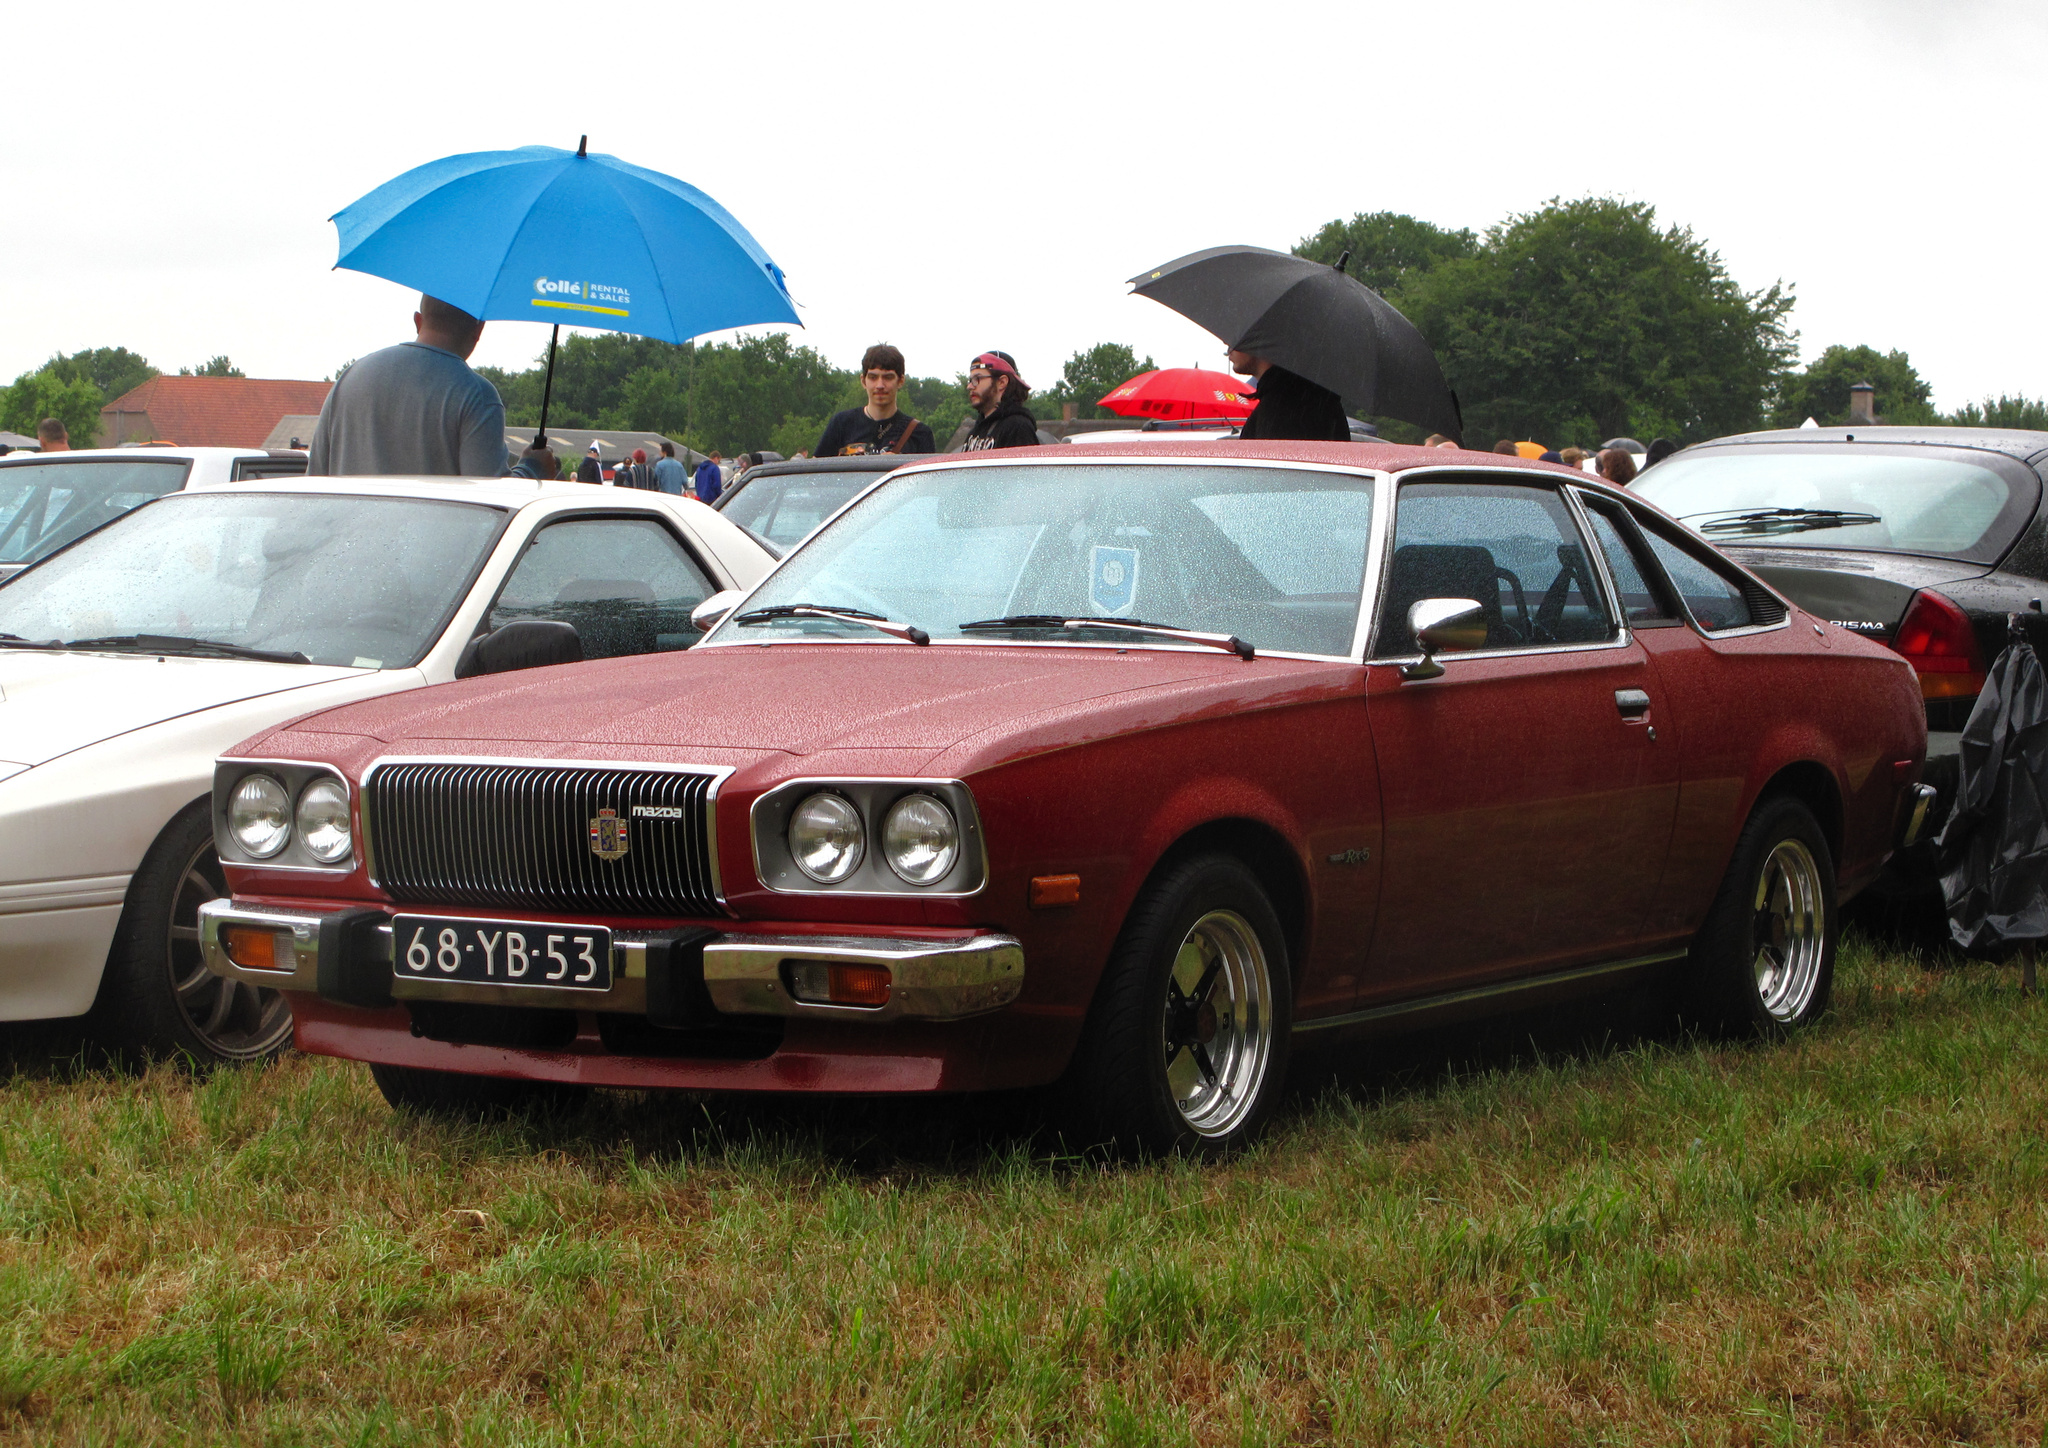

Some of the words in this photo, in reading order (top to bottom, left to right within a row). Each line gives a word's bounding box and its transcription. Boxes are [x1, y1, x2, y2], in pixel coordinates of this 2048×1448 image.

[534, 277, 581, 296] Collé
[590, 284, 630, 296] RENTAL
[599, 293, 630, 304] SALES
[407, 927, 597, 982] 68-YB-53
